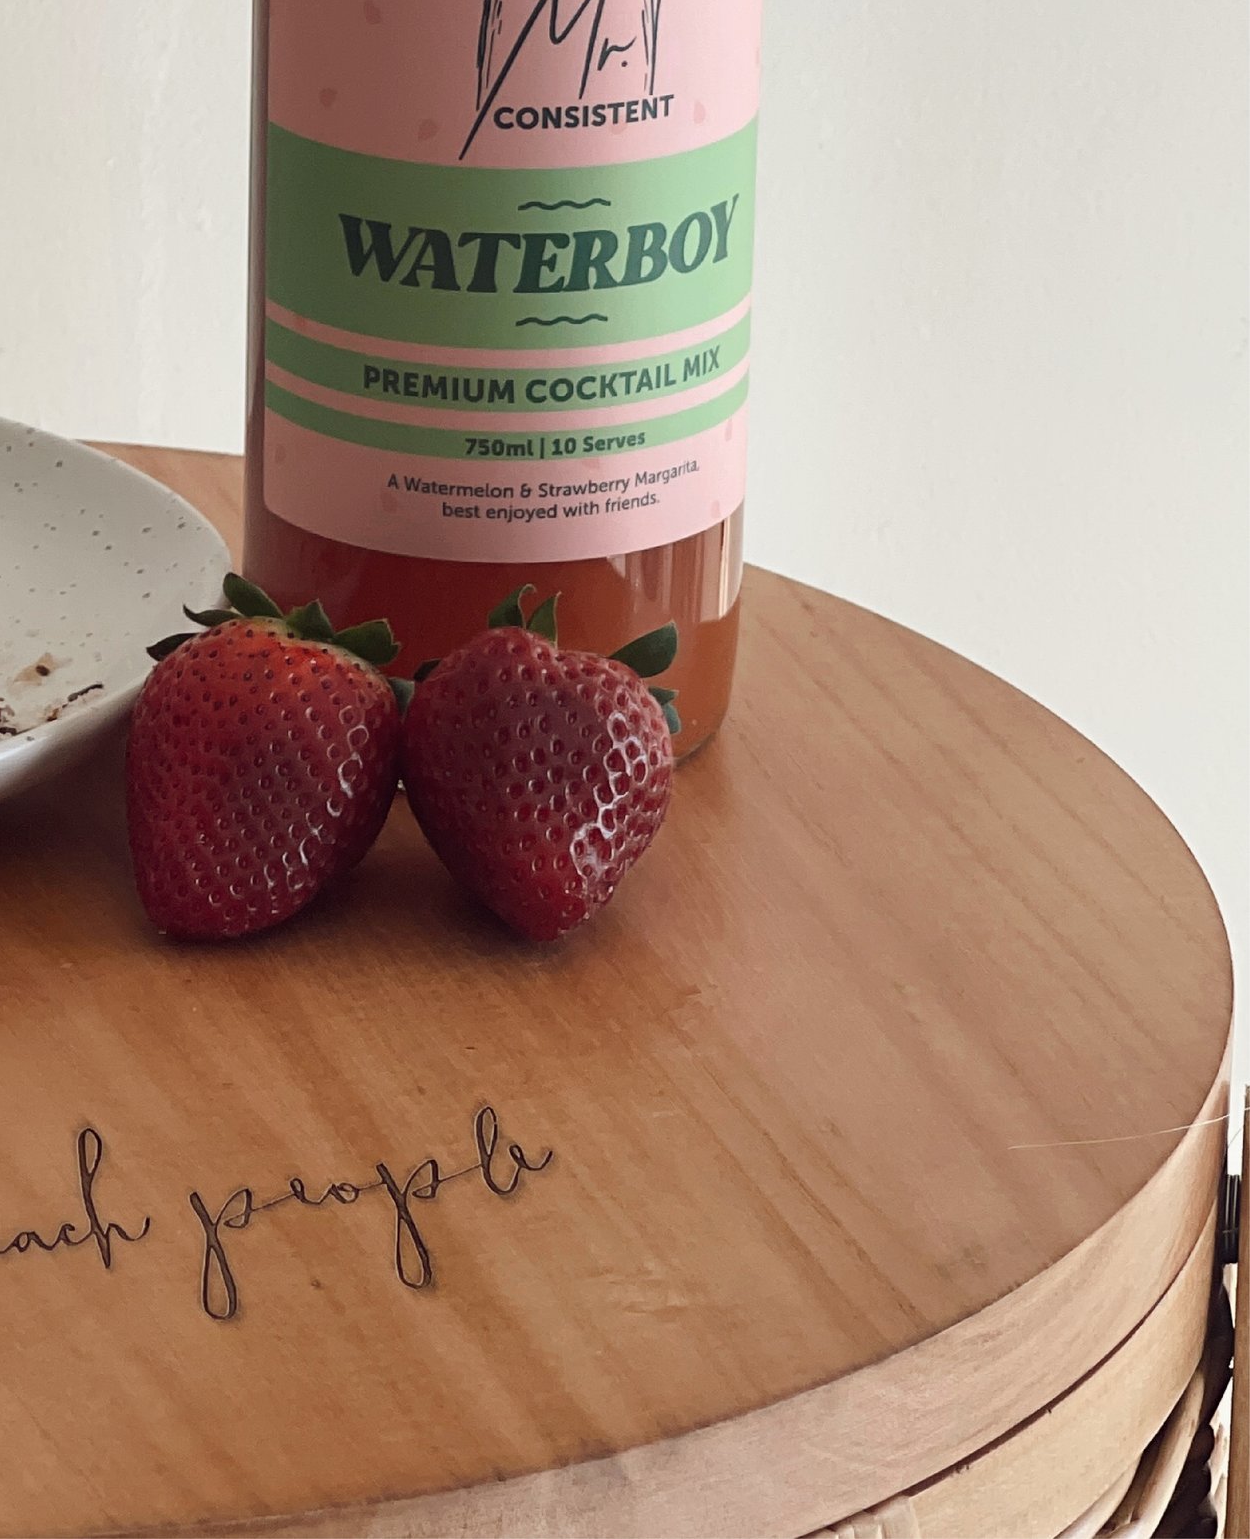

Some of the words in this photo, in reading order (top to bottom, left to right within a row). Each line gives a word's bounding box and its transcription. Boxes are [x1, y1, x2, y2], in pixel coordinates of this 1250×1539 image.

[493, 94, 674, 130] CONSISTENT
[338, 193, 740, 294] WATERBOY
[363, 364, 516, 404] PREMIUM
[525, 362, 677, 404] COCKTAIL
[683, 345, 721, 382] MIX
[465, 437, 534, 457] 750ml
[551, 437, 577, 456] 10
[582, 431, 646, 453] Serves
[387, 473, 399, 490] A
[404, 475, 514, 499] Watermelon
[520, 483, 532, 499] &
[538, 477, 630, 498] Strawberry
[442, 502, 481, 519] best
[485, 504, 558, 523] enjoyed
[563, 501, 599, 518] with
[605, 491, 661, 513] friends.
[190, 1105, 554, 1320] people
